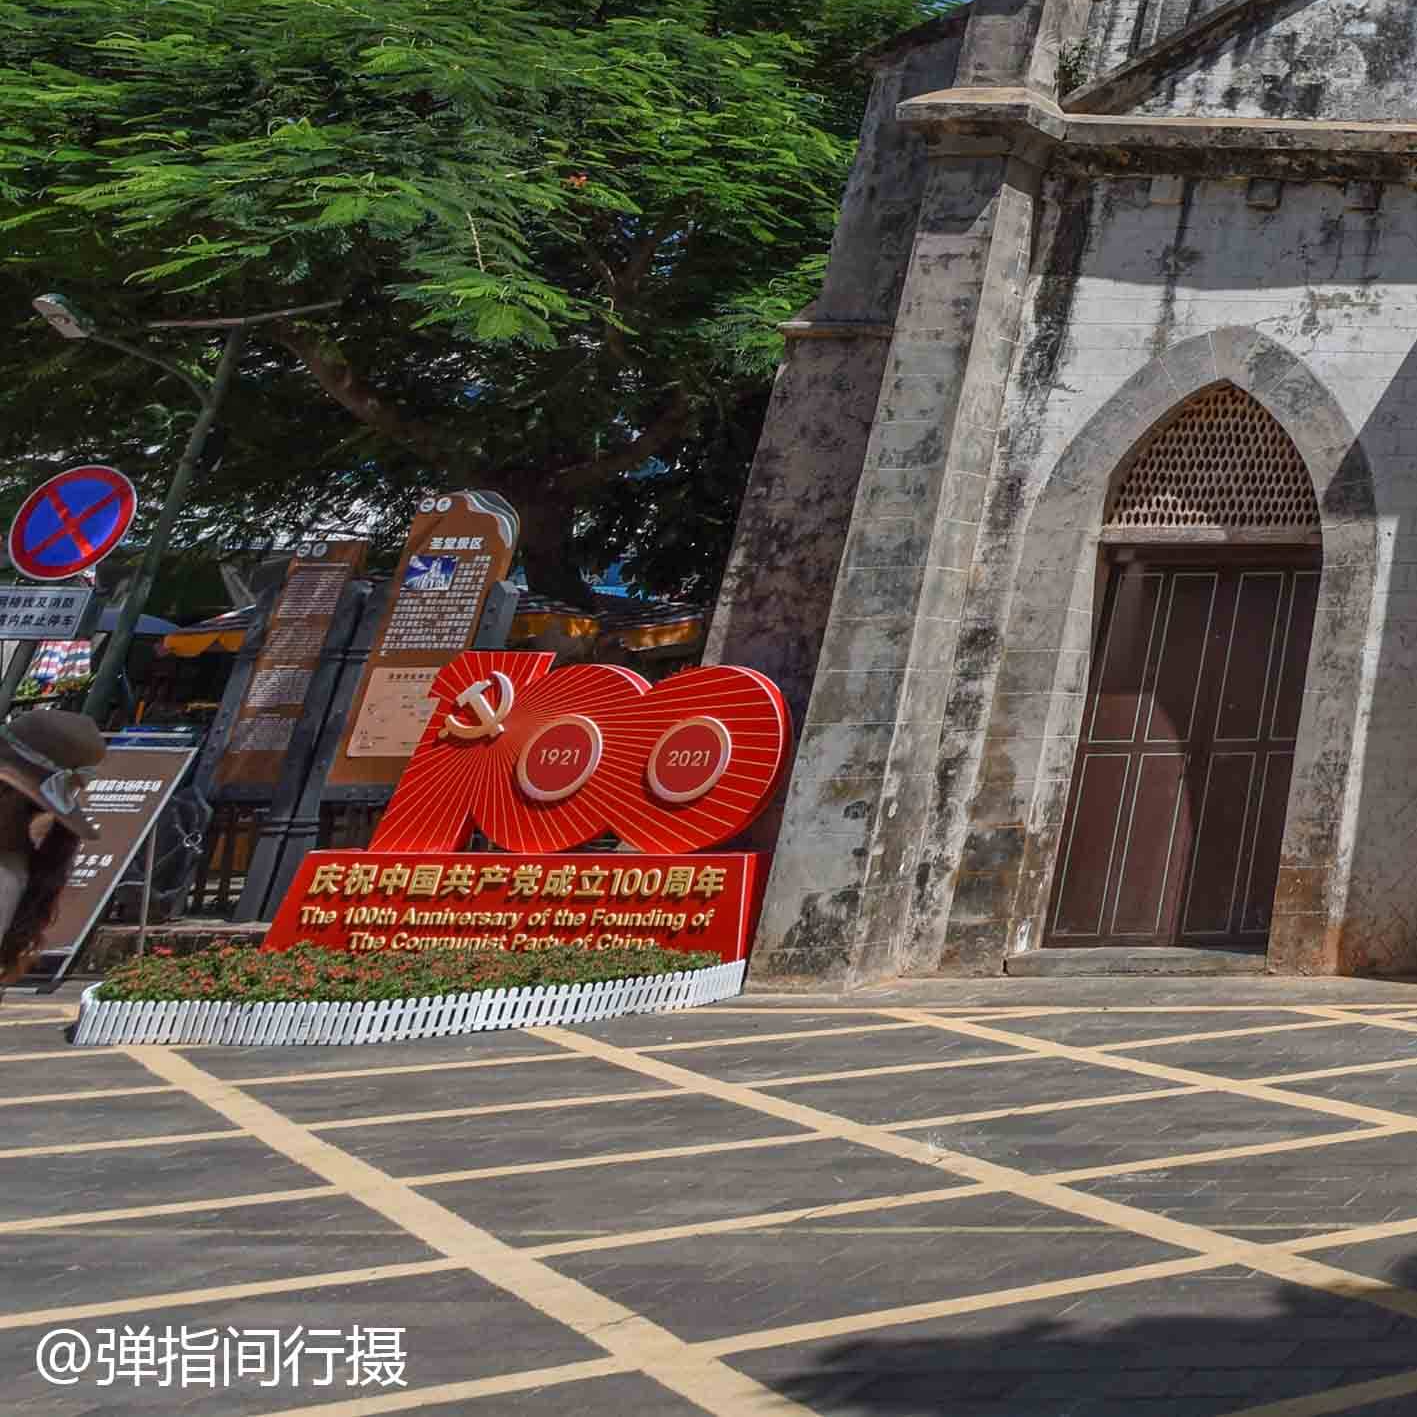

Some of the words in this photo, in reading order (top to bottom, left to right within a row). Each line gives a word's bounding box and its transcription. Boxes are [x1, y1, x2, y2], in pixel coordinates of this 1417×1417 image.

[539, 749, 581, 766] 1921
[665, 749, 711, 767] 2021
[308, 863, 727, 897] 庆祝中国共产党成立100周年
[301, 906, 337, 925] The
[344, 906, 398, 925] 100th
[400, 907, 522, 929] Anniversary
[527, 908, 551, 926] of
[553, 908, 586, 927] the
[590, 909, 686, 931] Founding
[691, 908, 715, 927] of
[350, 932, 386, 950] The
[390, 932, 507, 951] Communist
[569, 933, 594, 951] of
